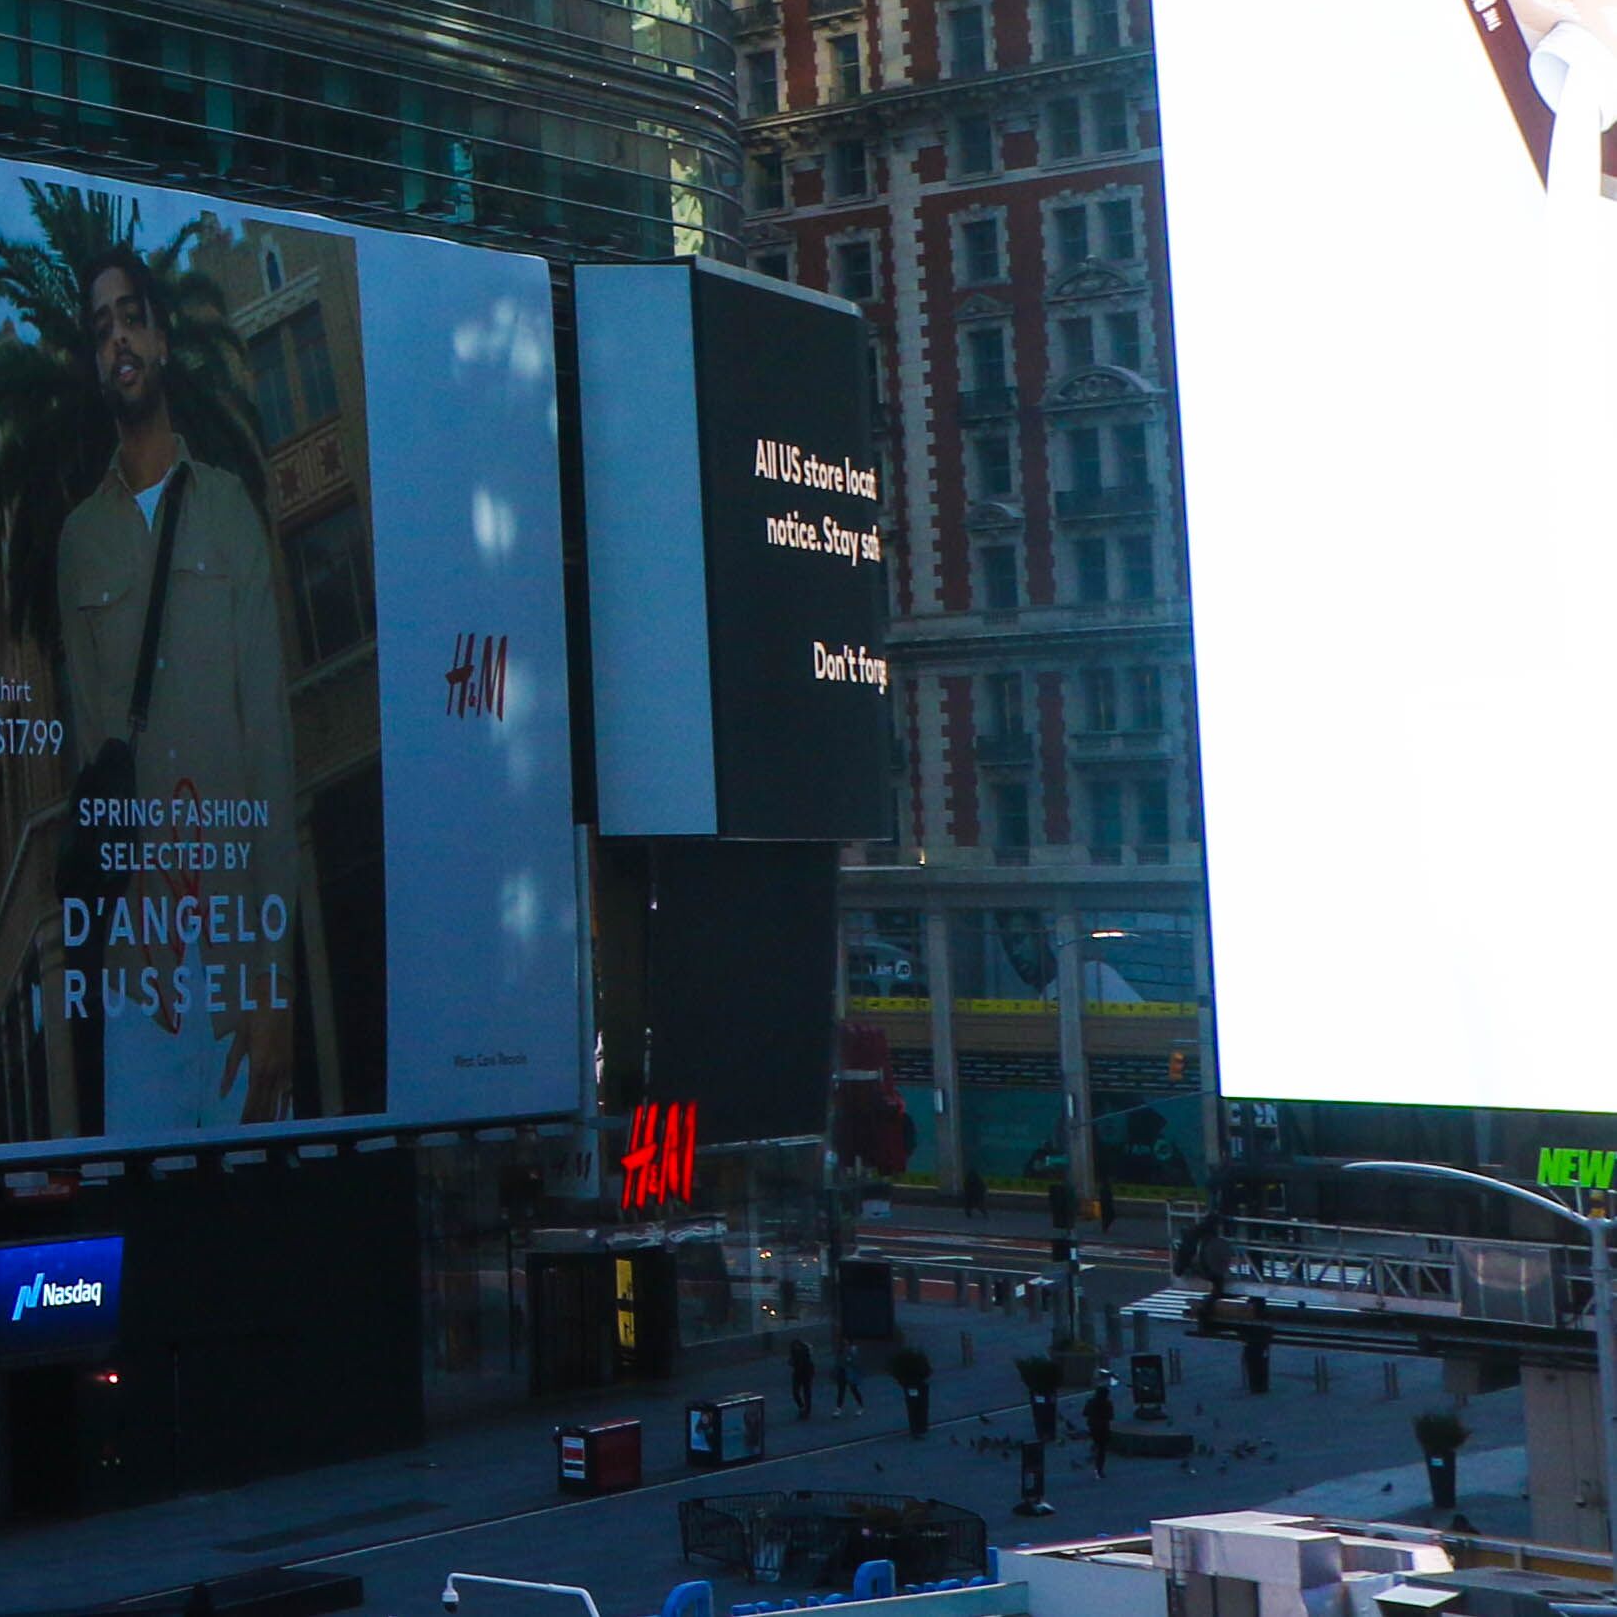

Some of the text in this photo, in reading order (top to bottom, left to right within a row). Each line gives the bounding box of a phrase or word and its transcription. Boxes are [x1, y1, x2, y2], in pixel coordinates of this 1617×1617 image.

[1482, 8, 1502, 31] THE
[754, 438, 776, 480] All
[778, 443, 801, 485] US
[803, 454, 843, 493] store
[766, 510, 821, 552] notice.
[823, 515, 859, 567] Stay
[445, 632, 508, 722] H&M
[813, 641, 856, 684] Don't
[77, 798, 269, 828] SPRING FASHION
[99, 841, 252, 871] SELECTED BY
[62, 893, 288, 948] D'ANGELO
[63, 962, 289, 1020] RUSSELL
[620, 1100, 699, 1211] H&M
[1537, 1146, 1615, 1190] NEW
[41, 1277, 103, 1308] Nasdaq
